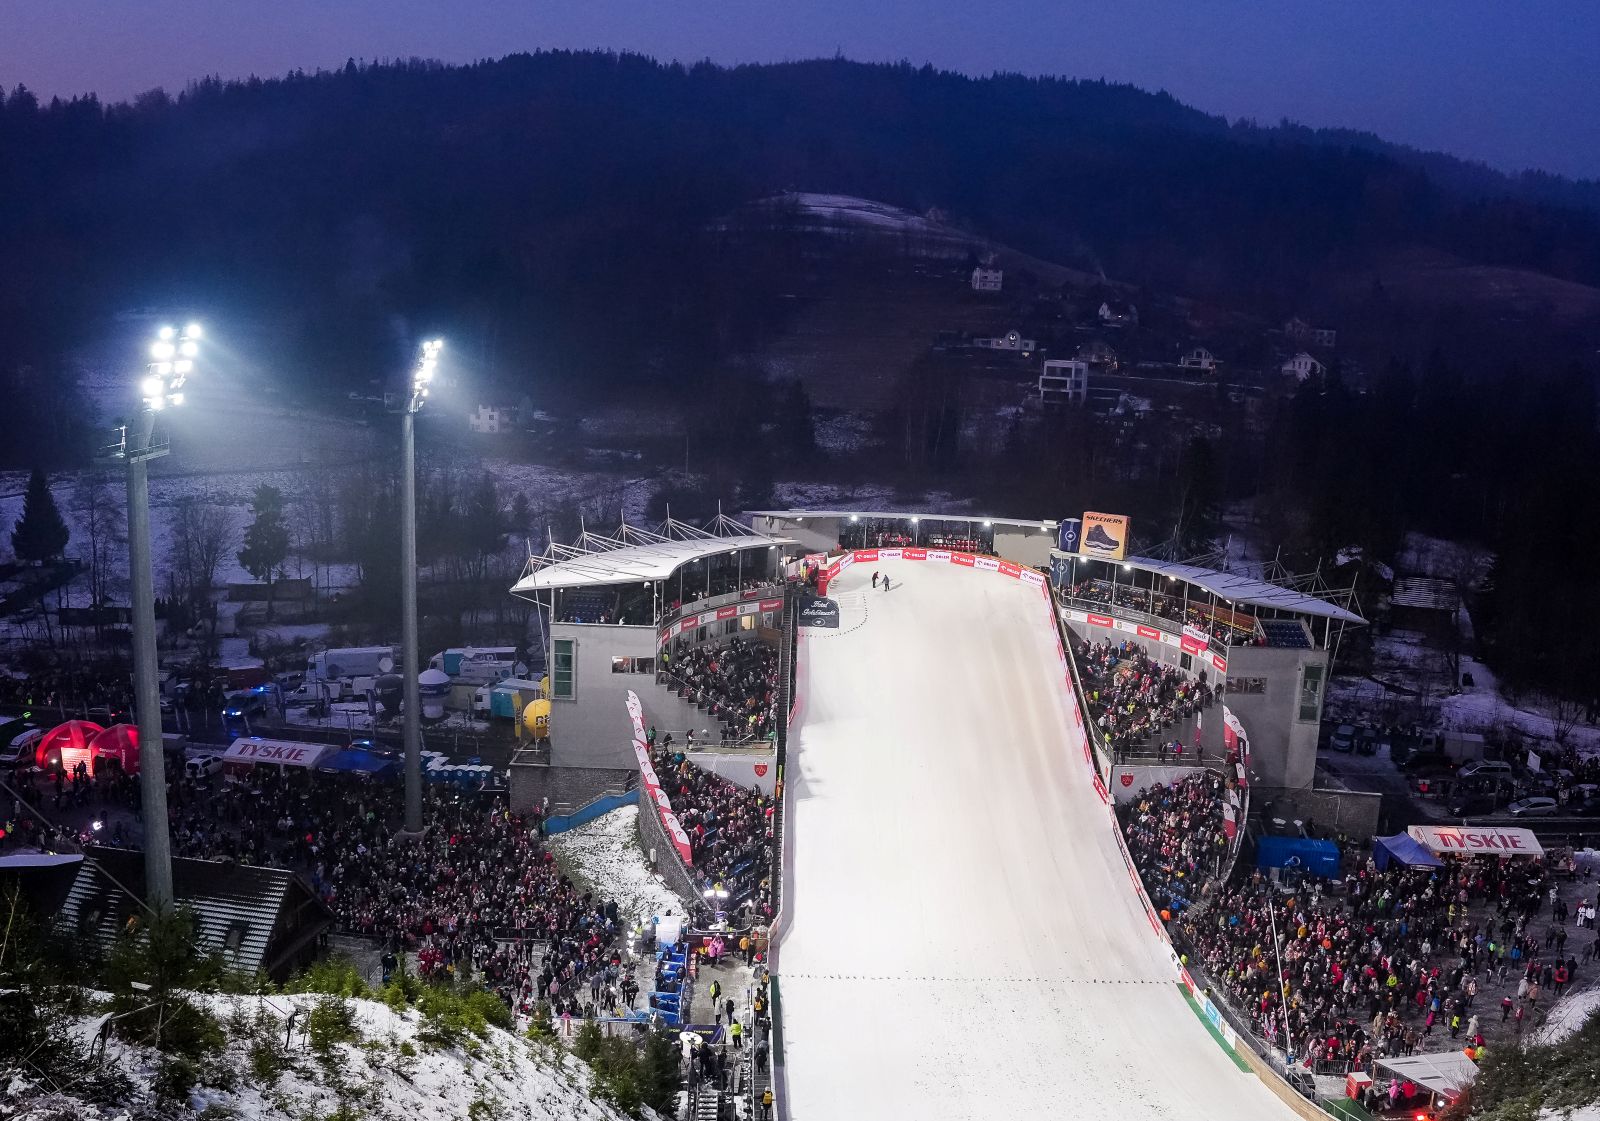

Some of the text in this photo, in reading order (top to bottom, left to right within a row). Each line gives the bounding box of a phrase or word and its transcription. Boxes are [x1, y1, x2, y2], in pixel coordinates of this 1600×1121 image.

[1086, 515, 1123, 524] SKECHERS
[238, 744, 309, 761] TYSKIE
[1433, 833, 1526, 849] TYSKIE
